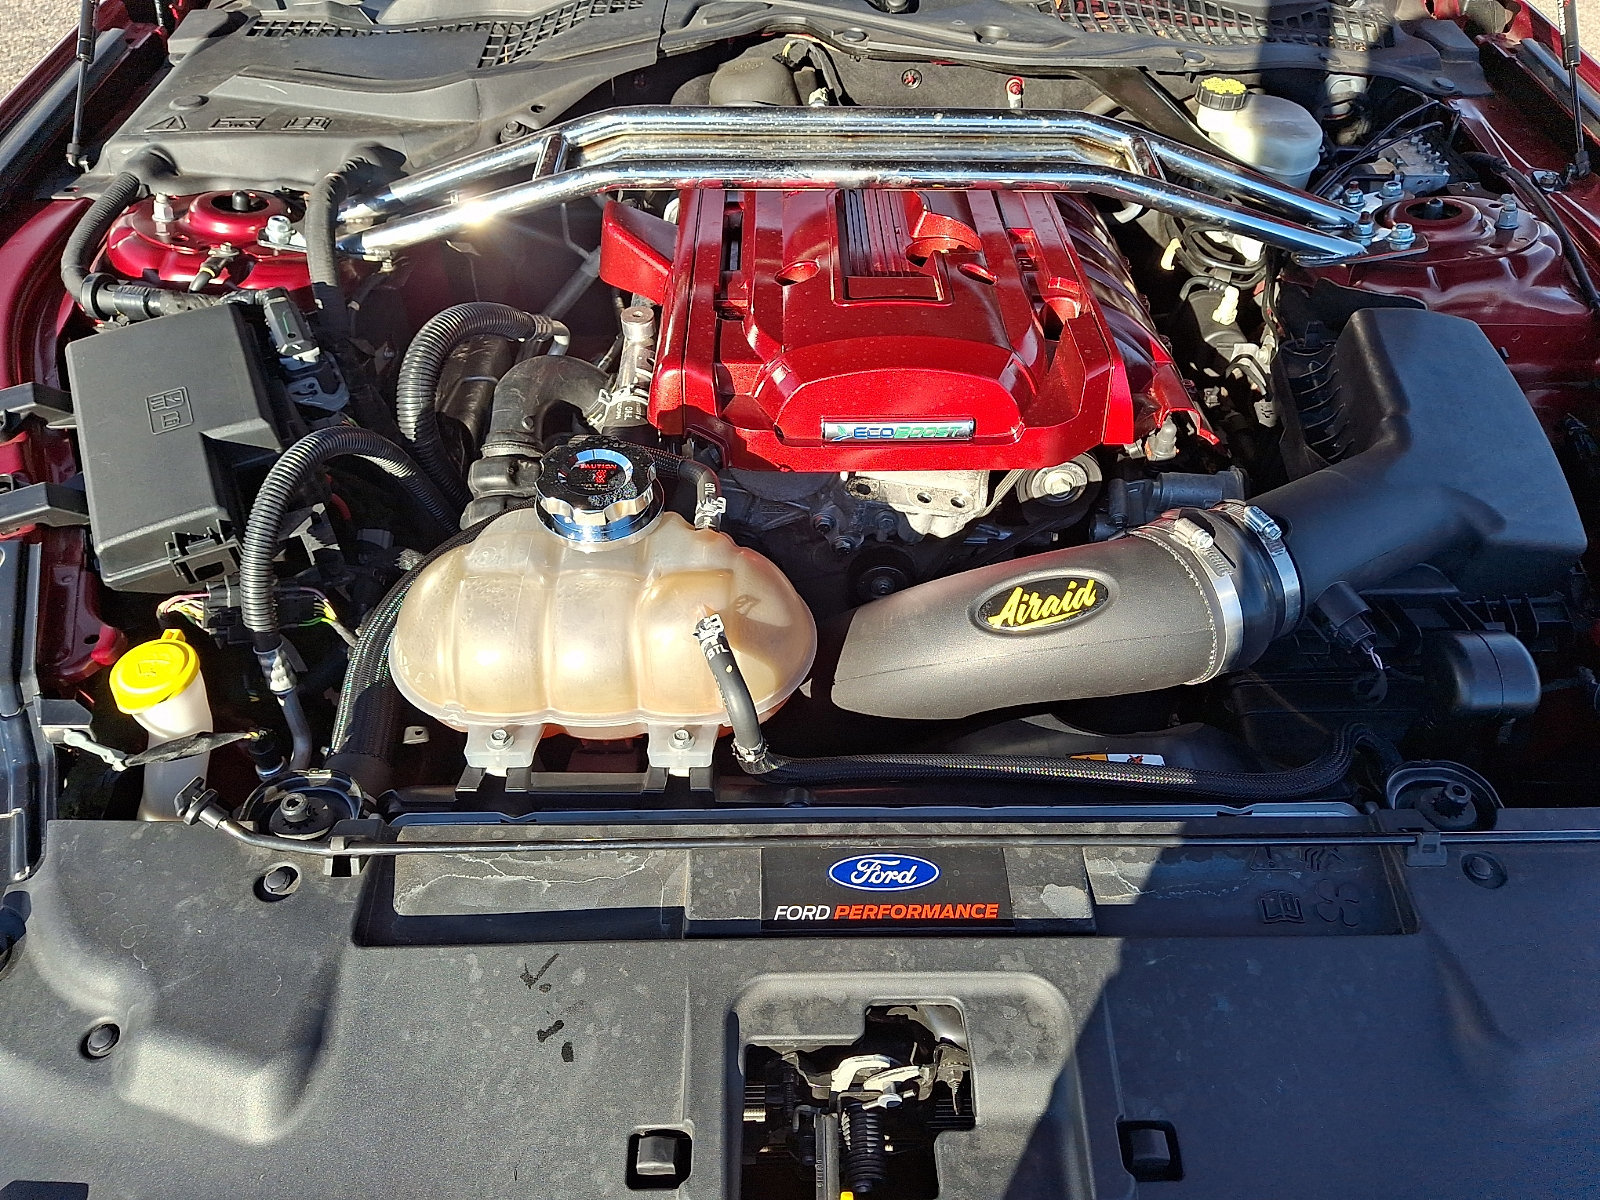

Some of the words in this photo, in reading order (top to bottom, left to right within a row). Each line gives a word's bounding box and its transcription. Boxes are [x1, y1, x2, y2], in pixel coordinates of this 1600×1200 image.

[853, 426, 962, 440] ECOBOOST
[987, 579, 1097, 630] Airaid
[850, 858, 918, 885] Ford
[773, 905, 831, 921] FORD
[833, 903, 999, 920] PERFORMANCE
